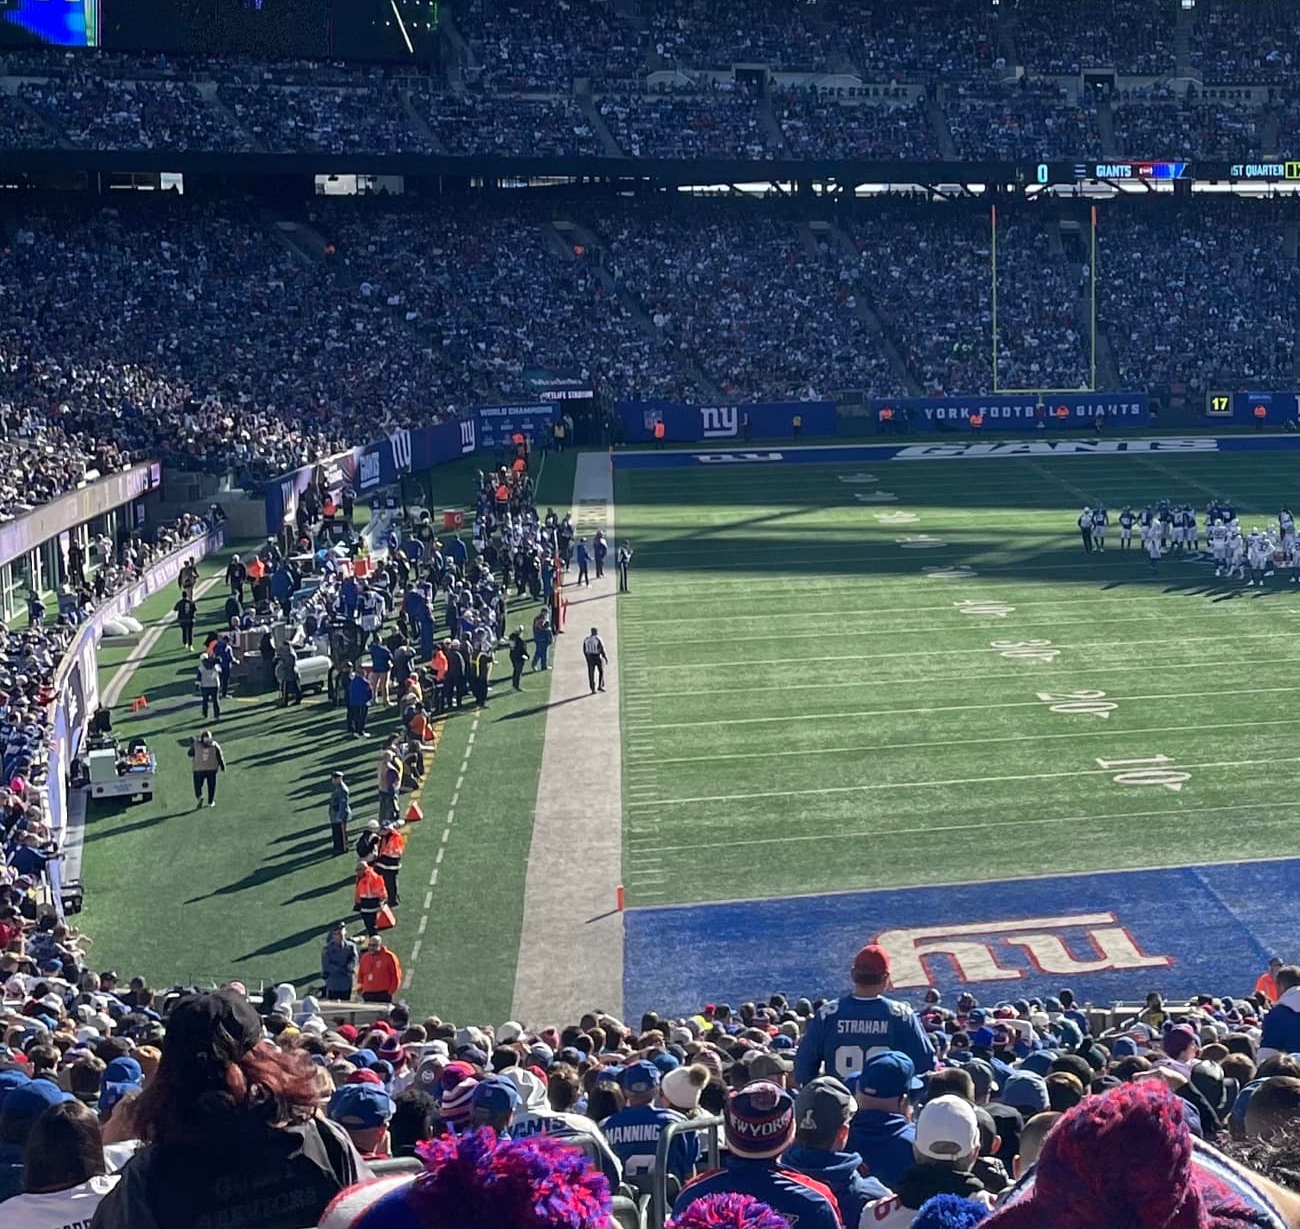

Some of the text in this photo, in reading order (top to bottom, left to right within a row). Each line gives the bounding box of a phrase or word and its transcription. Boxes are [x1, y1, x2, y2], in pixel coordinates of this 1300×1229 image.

[1037, 164, 1048, 183] 0
[1096, 164, 1132, 177] GIANTS
[1245, 165, 1284, 177] QUARTER
[480, 405, 553, 416] WORLD CHAMPIONS
[924, 408, 969, 420] YORK
[1076, 404, 1140, 416] GIANTS
[1212, 397, 1228, 411] 17
[700, 406, 738, 438] ny
[460, 420, 475, 453] ny
[389, 428, 412, 472] ny
[891, 439, 1219, 460] GIANTS
[990, 638, 1061, 658] 30
[1035, 689, 1119, 714] 20
[1096, 754, 1192, 785] 10
[874, 911, 1173, 990] ny
[837, 1019, 888, 1034] STRAHAN
[604, 1123, 661, 1145] MANNING
